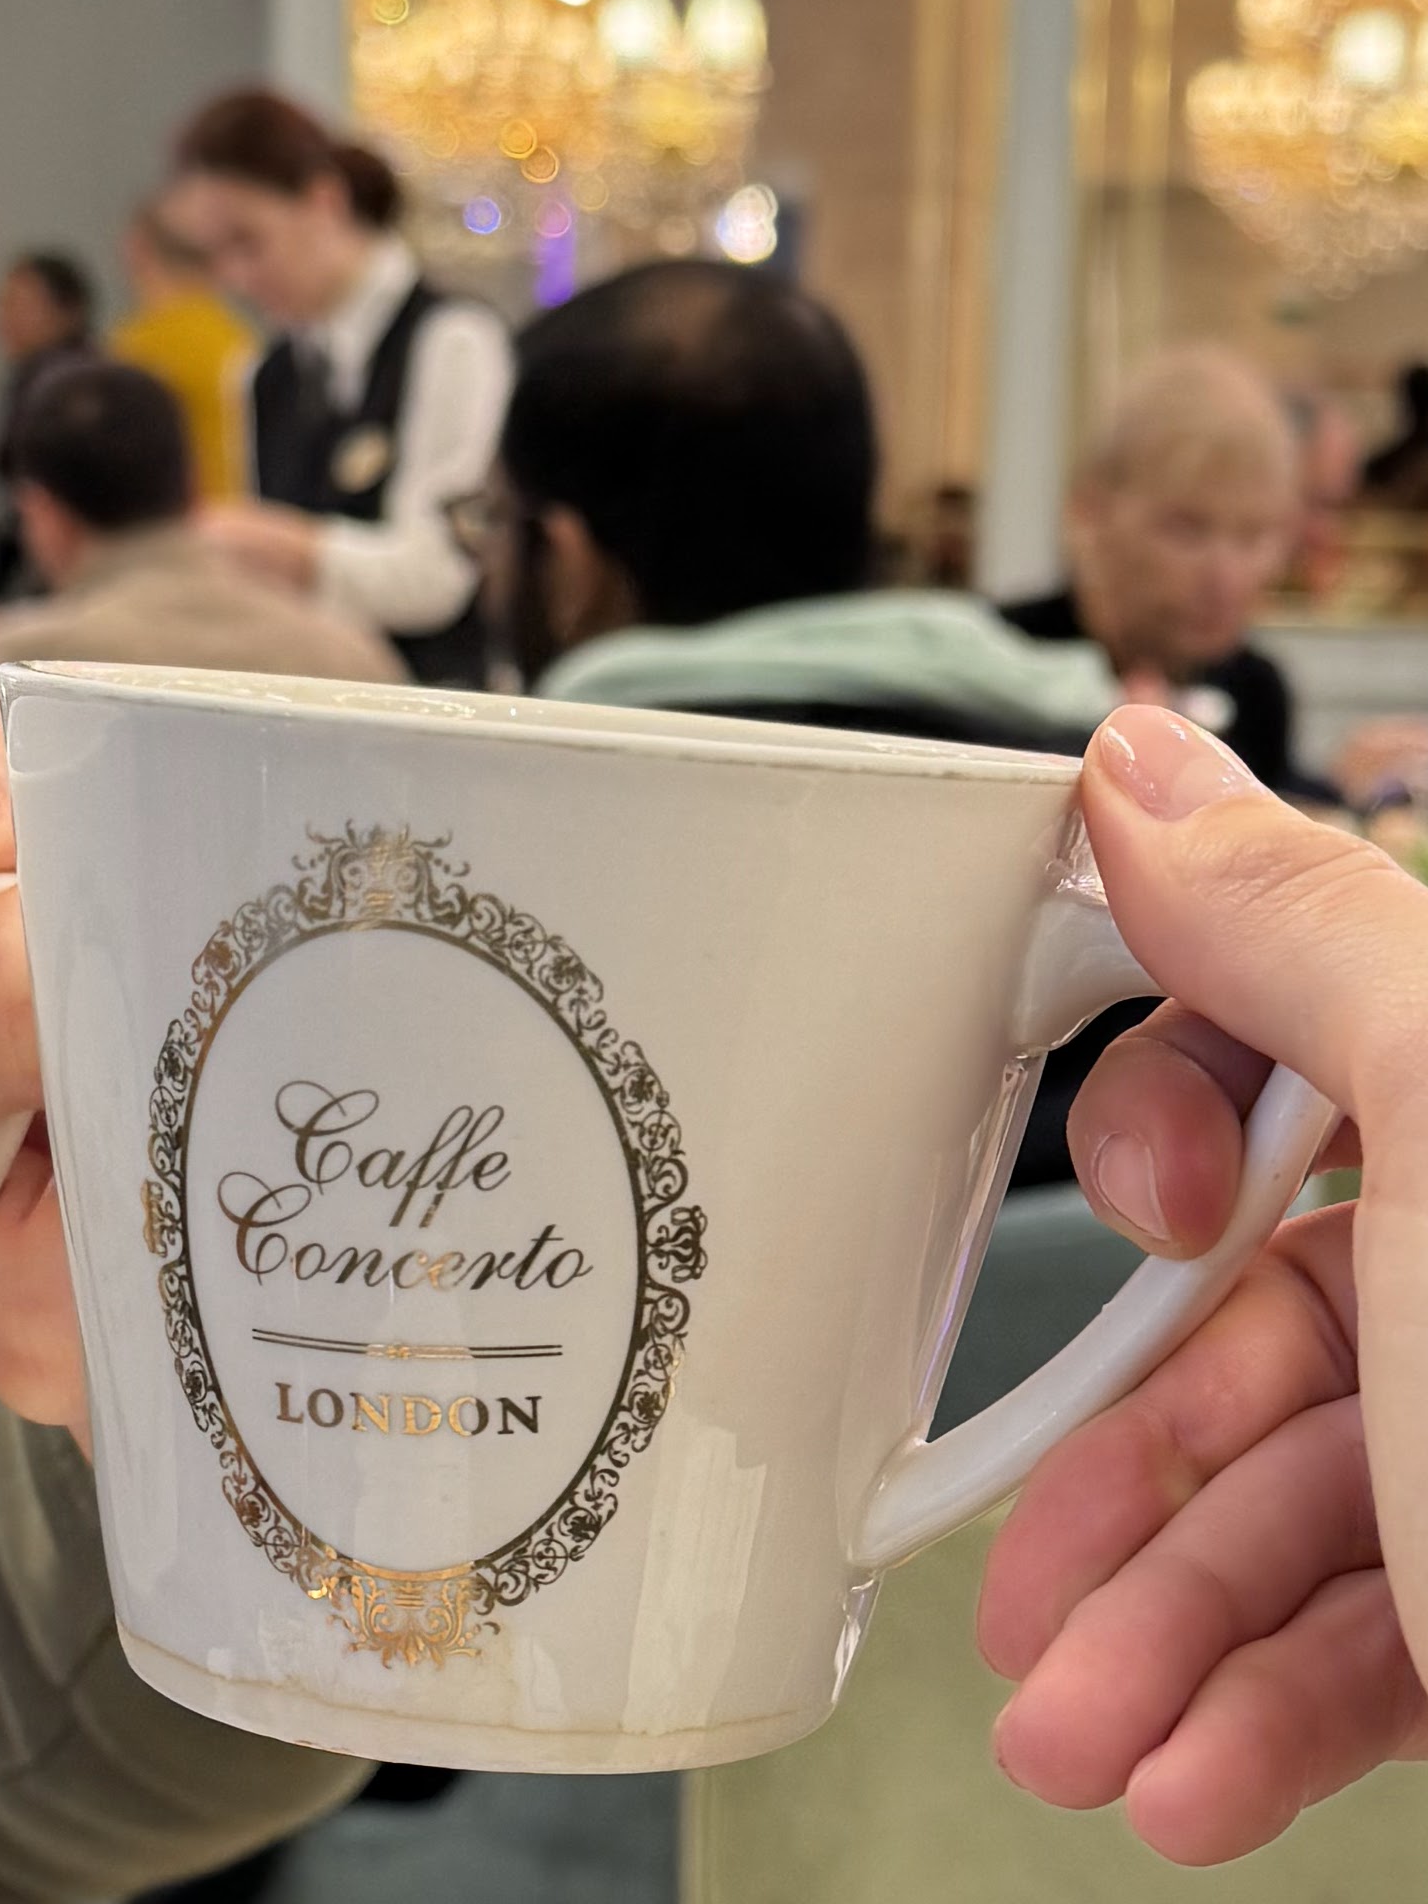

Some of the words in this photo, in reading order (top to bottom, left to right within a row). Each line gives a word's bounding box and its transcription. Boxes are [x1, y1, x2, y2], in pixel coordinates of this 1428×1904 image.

[275, 1079, 510, 1228] Caffe
[217, 1171, 592, 1294] Concerto
[275, 1382, 542, 1437] LONDON
